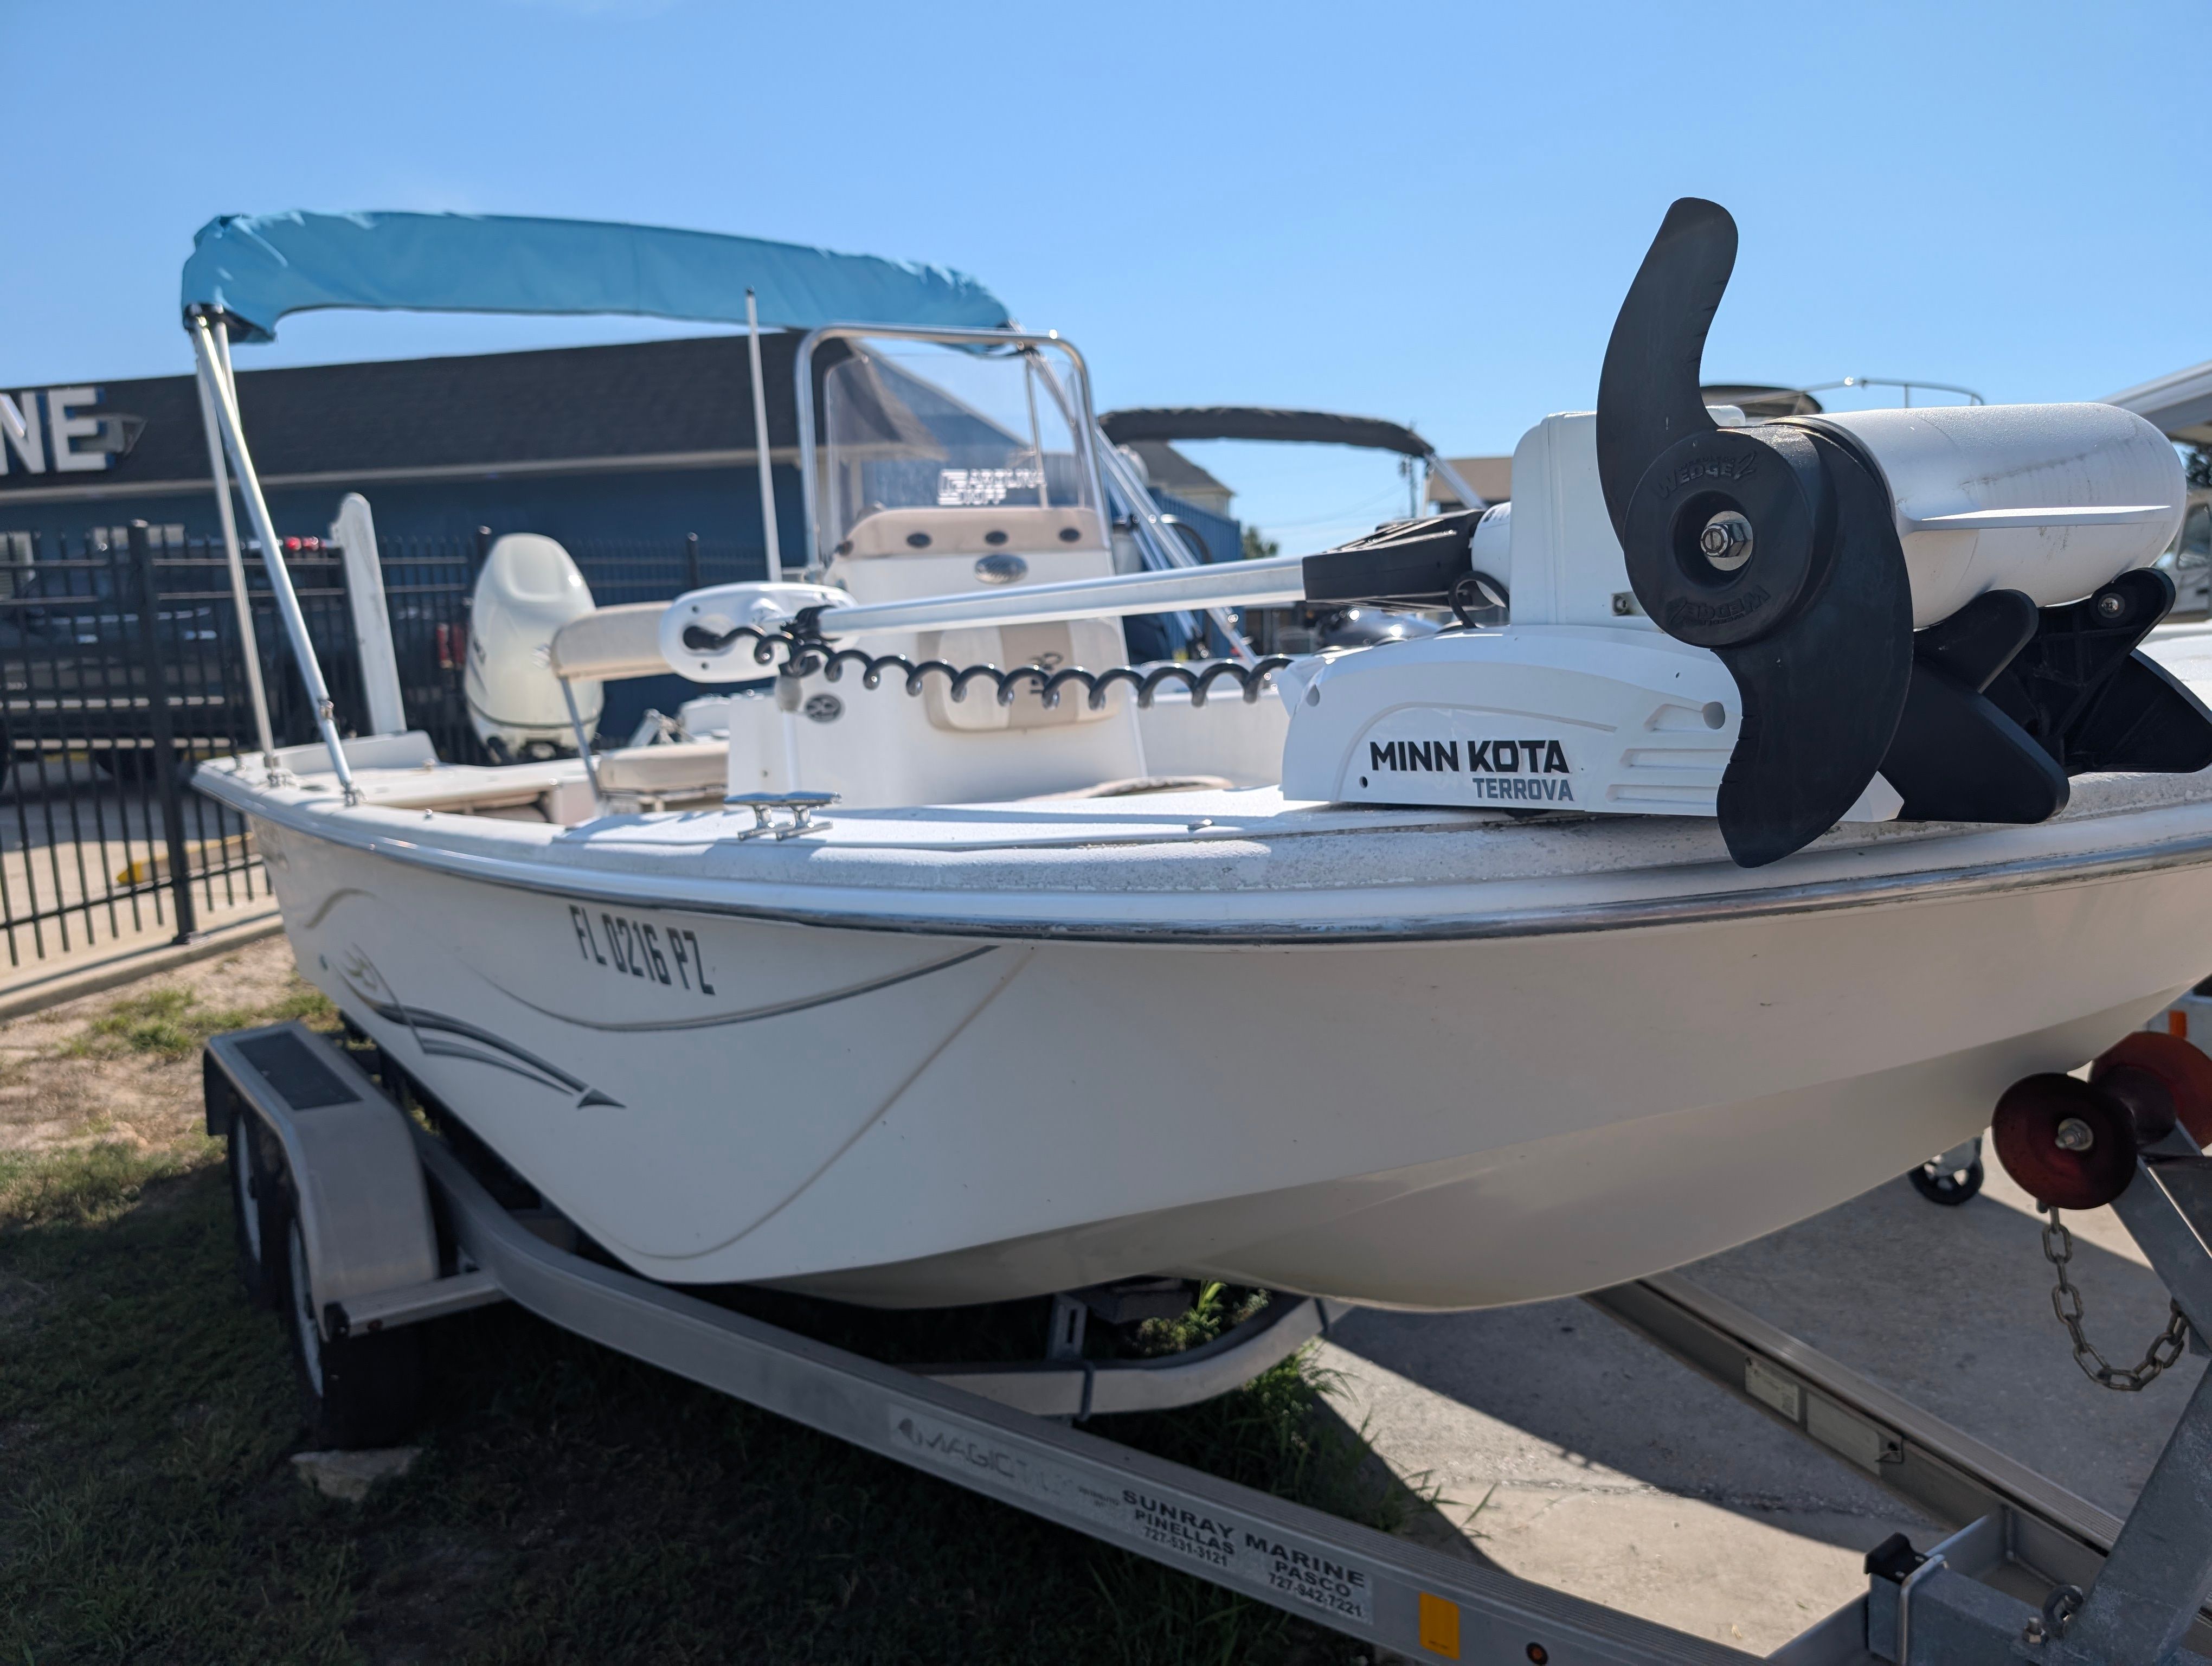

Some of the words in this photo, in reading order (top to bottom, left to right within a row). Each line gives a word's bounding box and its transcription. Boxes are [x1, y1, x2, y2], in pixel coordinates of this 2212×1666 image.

[1369, 740, 1459, 772] MINN
[1468, 740, 1570, 774] KOTA
[1472, 777, 1574, 802] TERROVA
[569, 904, 607, 966] FL
[601, 912, 672, 986] 0216
[666, 926, 716, 995] PZ
[1122, 1489, 1234, 1539] SUNRAY
[1245, 1532, 1365, 1588] MARINE
[1135, 1509, 1234, 1555] PINELLAS
[1143, 1526, 1228, 1567] 727-531-3121
[1268, 1572, 1363, 1618] 727-942-7221
[1275, 1560, 1352, 1598] PASCO
